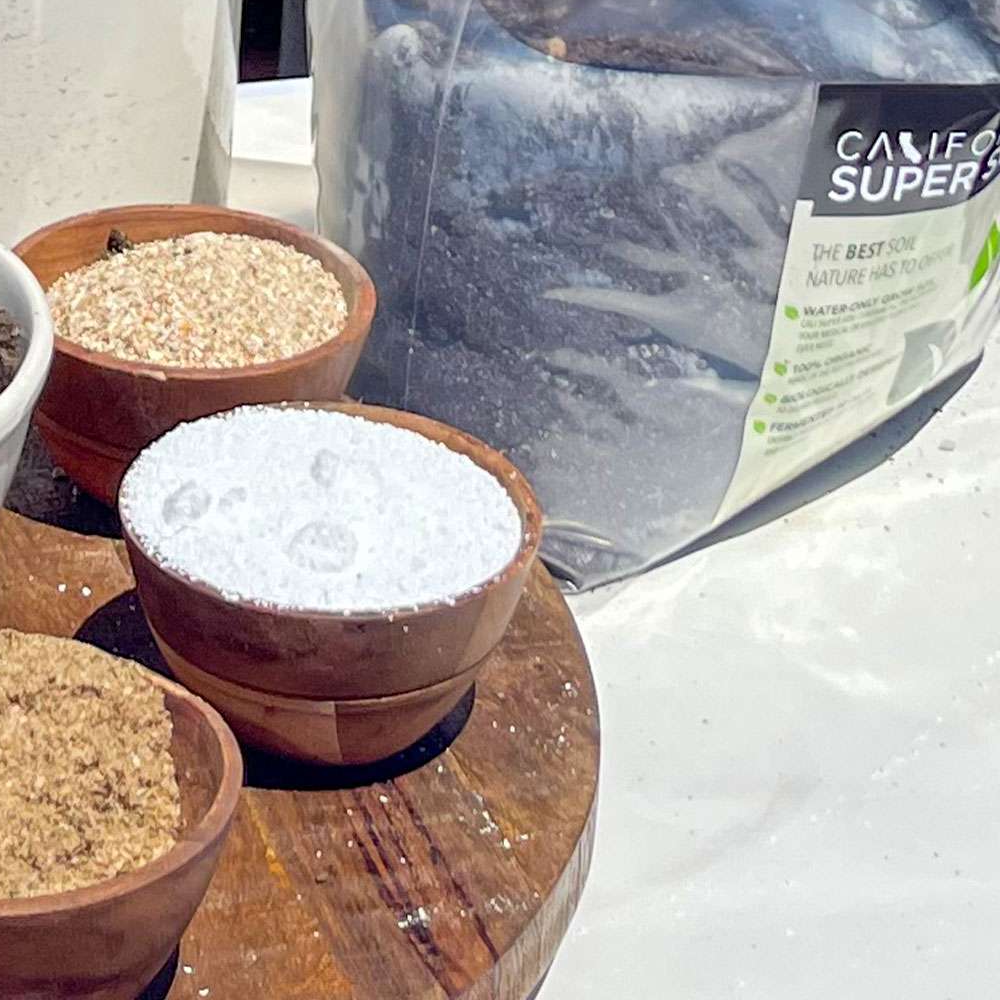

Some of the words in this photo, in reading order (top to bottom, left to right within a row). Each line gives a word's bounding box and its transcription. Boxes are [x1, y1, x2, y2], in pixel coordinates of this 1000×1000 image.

[836, 130, 1000, 164] CALIFO
[812, 242, 843, 262] THE
[845, 240, 885, 260] BEST
[886, 235, 918, 256] SOIL
[806, 267, 867, 288] NATURE
[869, 261, 896, 282] HAS
[899, 258, 917, 274] TO
